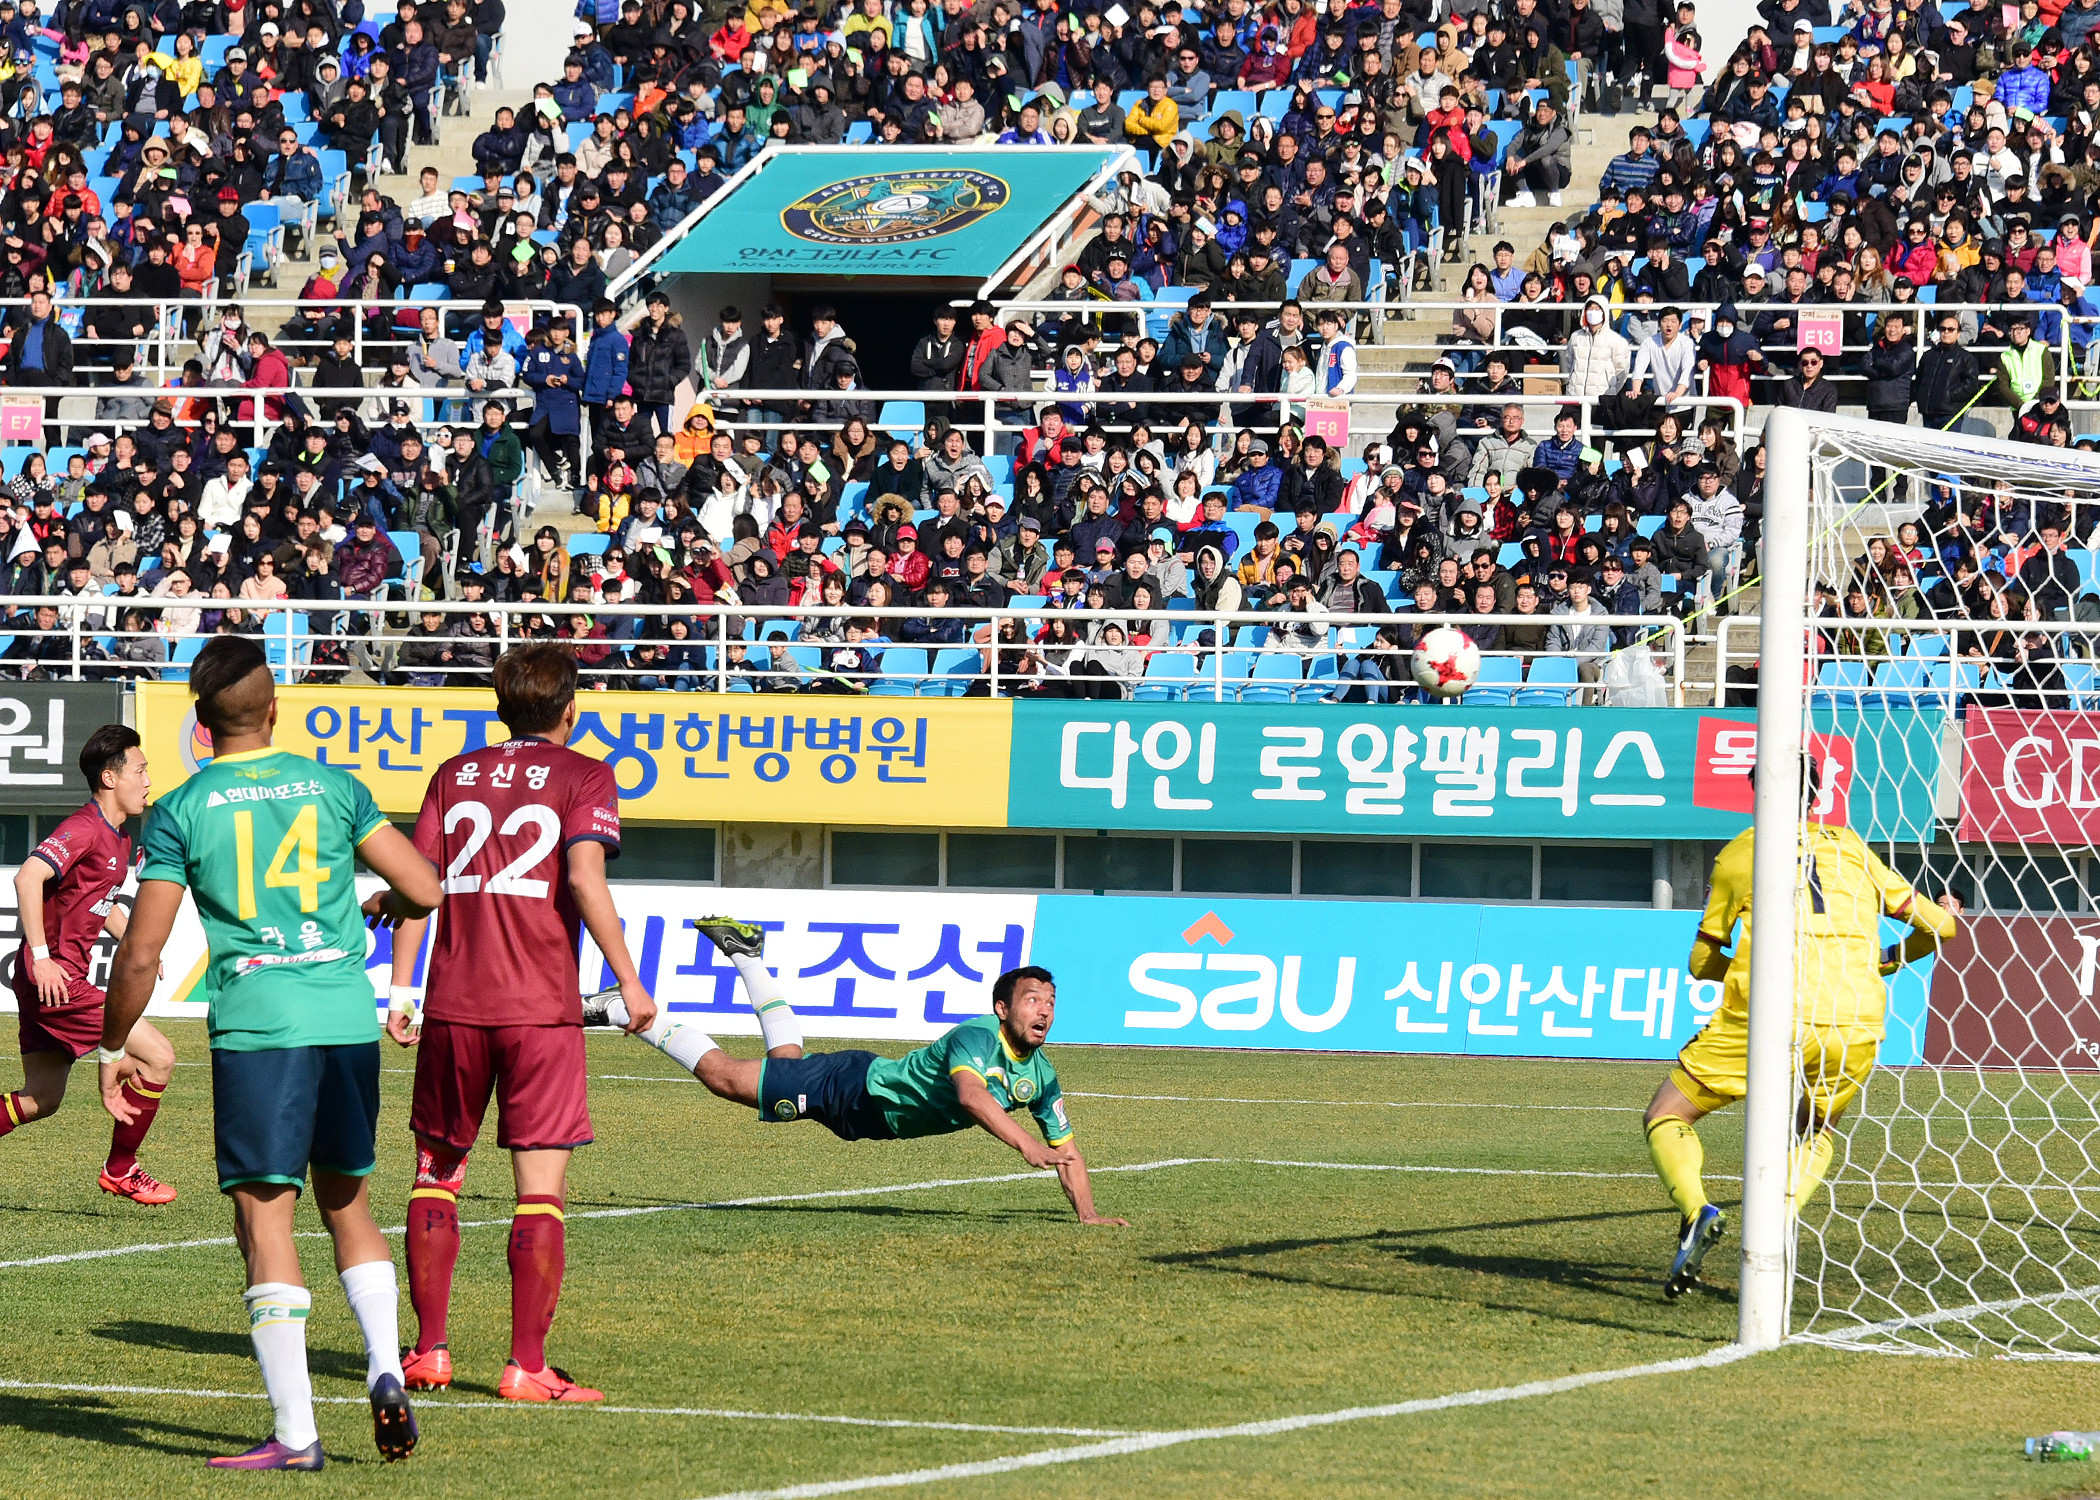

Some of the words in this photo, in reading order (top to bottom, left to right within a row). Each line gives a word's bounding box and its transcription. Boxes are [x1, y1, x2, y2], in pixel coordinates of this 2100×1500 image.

[821, 175, 885, 198] ANSAN
[901, 171, 990, 185] GREENERS
[986, 183, 999, 197] FC
[804, 228, 851, 243] GREEN
[860, 228, 937, 243] WOLVES
[1805, 330, 1834, 345] E13
[11, 415, 32, 430] E7
[1316, 421, 1338, 437] E8
[455, 762, 551, 790] 윤신영
[1060, 719, 1217, 810] 다인
[1251, 723, 1666, 817] 로얄팰리스
[224, 779, 326, 803] 현대미포조선
[234, 804, 330, 920] 14
[442, 800, 562, 899] 22
